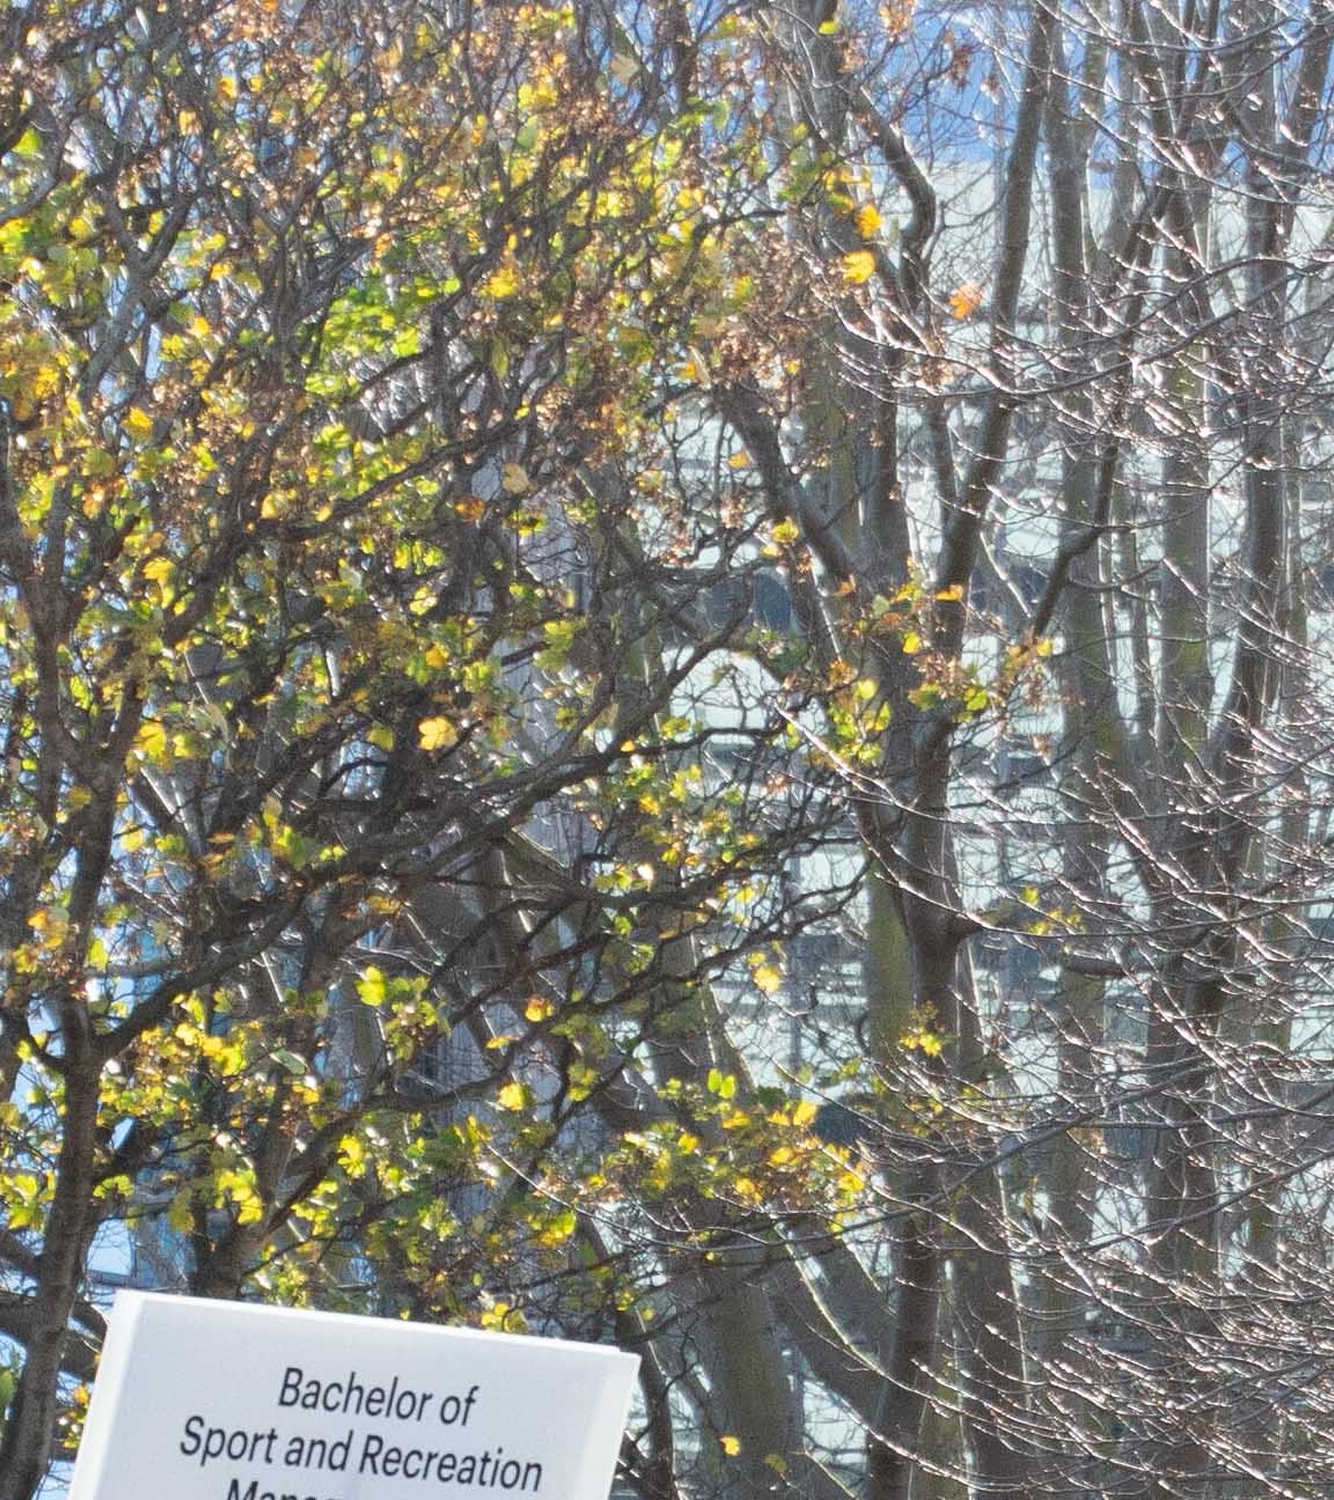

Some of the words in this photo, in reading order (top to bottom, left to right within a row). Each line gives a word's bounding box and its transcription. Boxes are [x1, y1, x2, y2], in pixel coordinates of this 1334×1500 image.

[277, 1366, 434, 1422] Bachelor
[439, 1384, 480, 1427] of
[179, 1414, 279, 1467] Sport
[283, 1429, 355, 1472] and
[358, 1433, 543, 1493] Recreation
